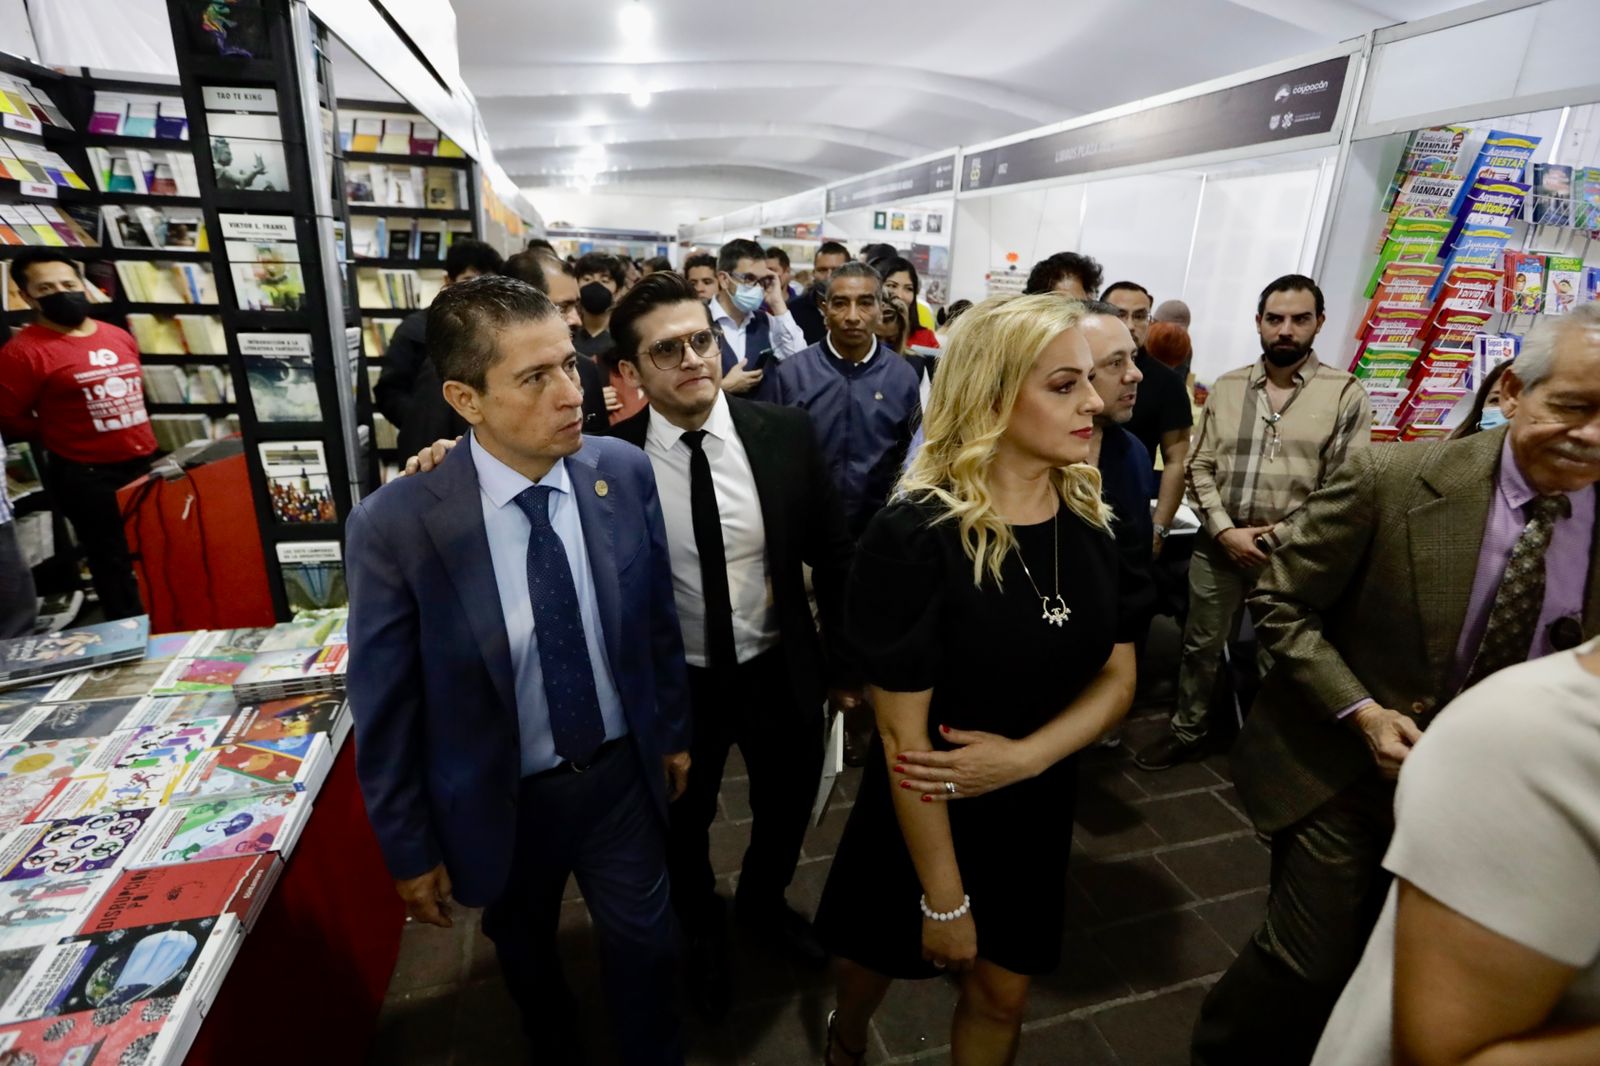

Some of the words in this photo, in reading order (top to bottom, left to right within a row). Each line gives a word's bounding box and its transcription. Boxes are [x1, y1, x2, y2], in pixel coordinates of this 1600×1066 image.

[216, 92, 231, 100] TAO
[233, 92, 241, 100] TE
[244, 93, 263, 101] KING
[1489, 157, 1526, 168] RESTAR
[1409, 186, 1456, 198] MANDALAS
[262, 223, 288, 231] FRANKL
